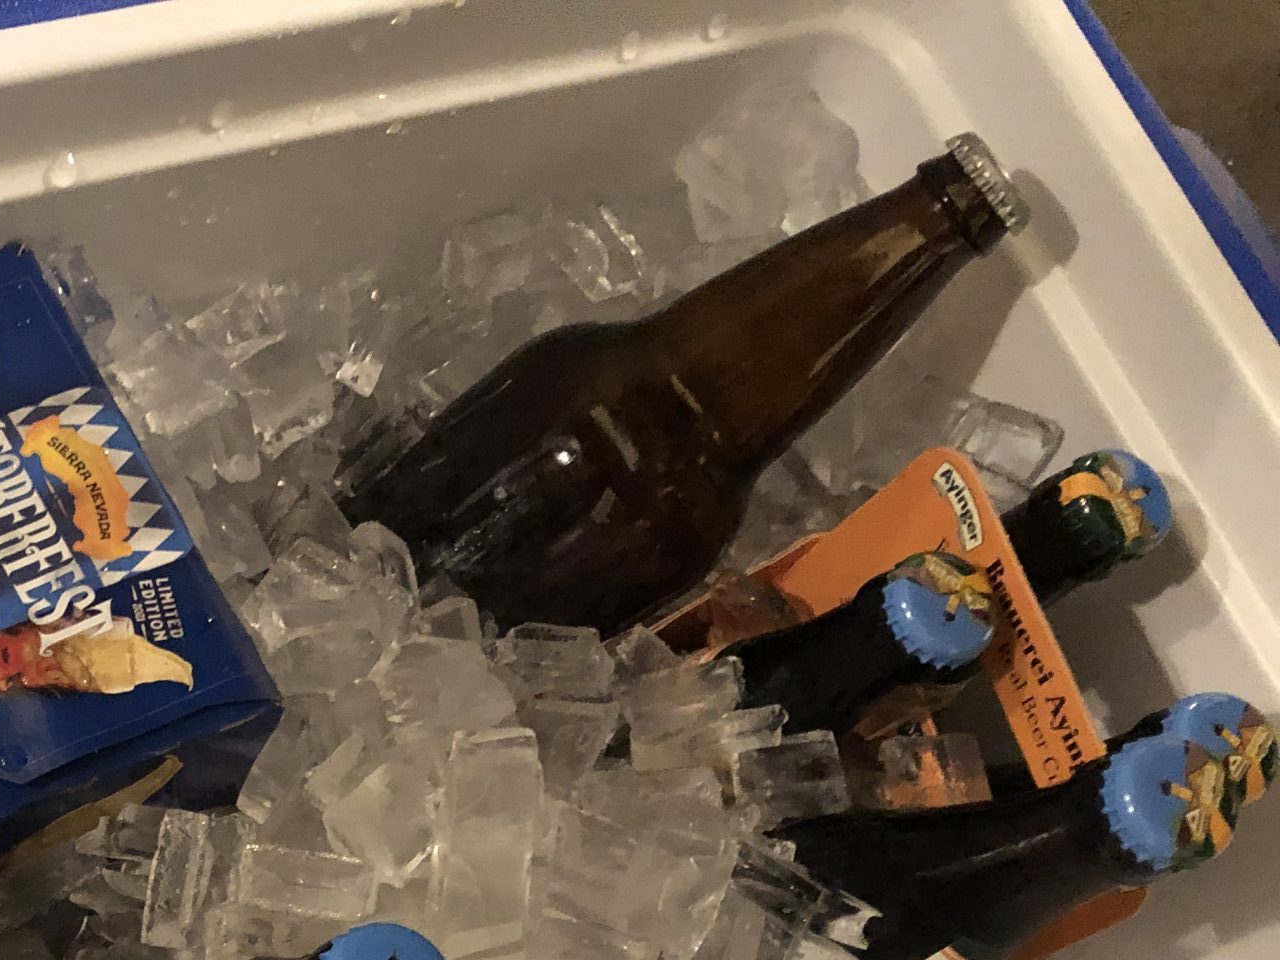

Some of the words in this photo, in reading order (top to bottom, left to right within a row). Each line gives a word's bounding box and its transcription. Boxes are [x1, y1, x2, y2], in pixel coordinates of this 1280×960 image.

[46, 435, 93, 483] SIERRA
[87, 476, 112, 541] NEVADA
[939, 466, 979, 543] Ayinger
[139, 580, 168, 642] EDITION
[156, 577, 184, 638] LIMITED
[986, 558, 1054, 687] Brauerei
